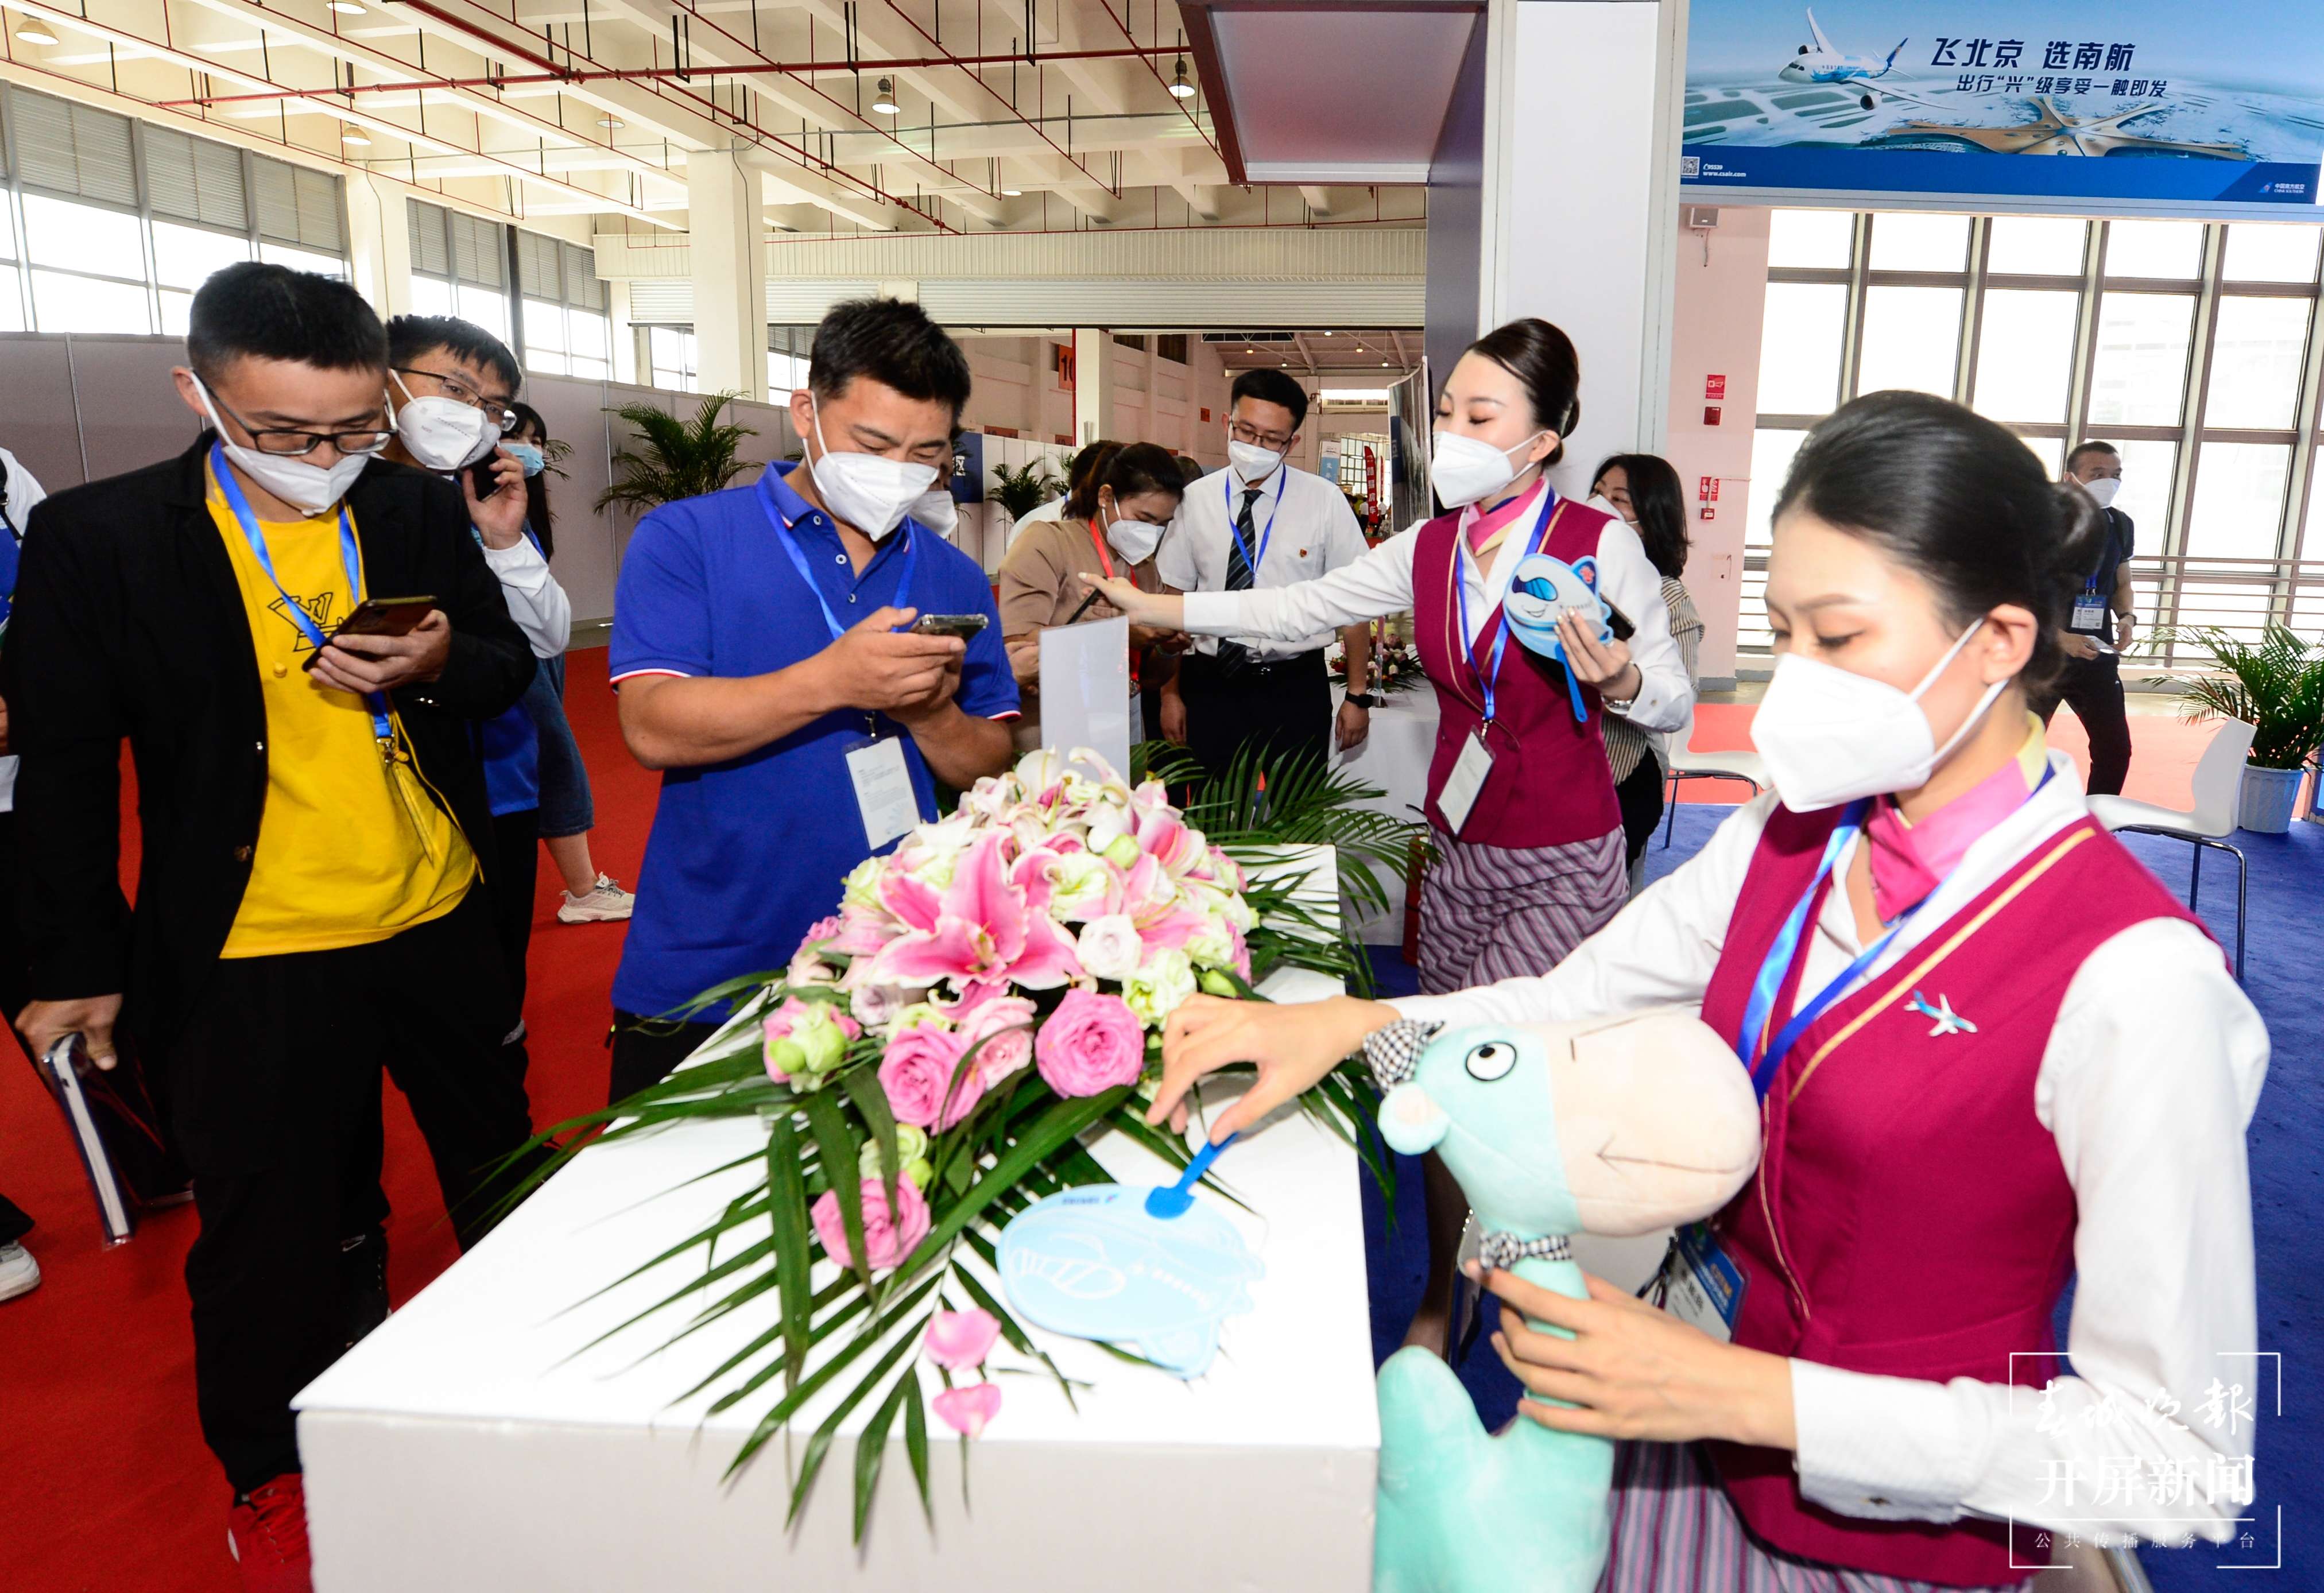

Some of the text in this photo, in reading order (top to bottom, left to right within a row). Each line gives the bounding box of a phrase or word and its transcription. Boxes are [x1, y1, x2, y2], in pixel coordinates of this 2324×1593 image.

[1931, 38, 2136, 71] 飞北京 选南航
